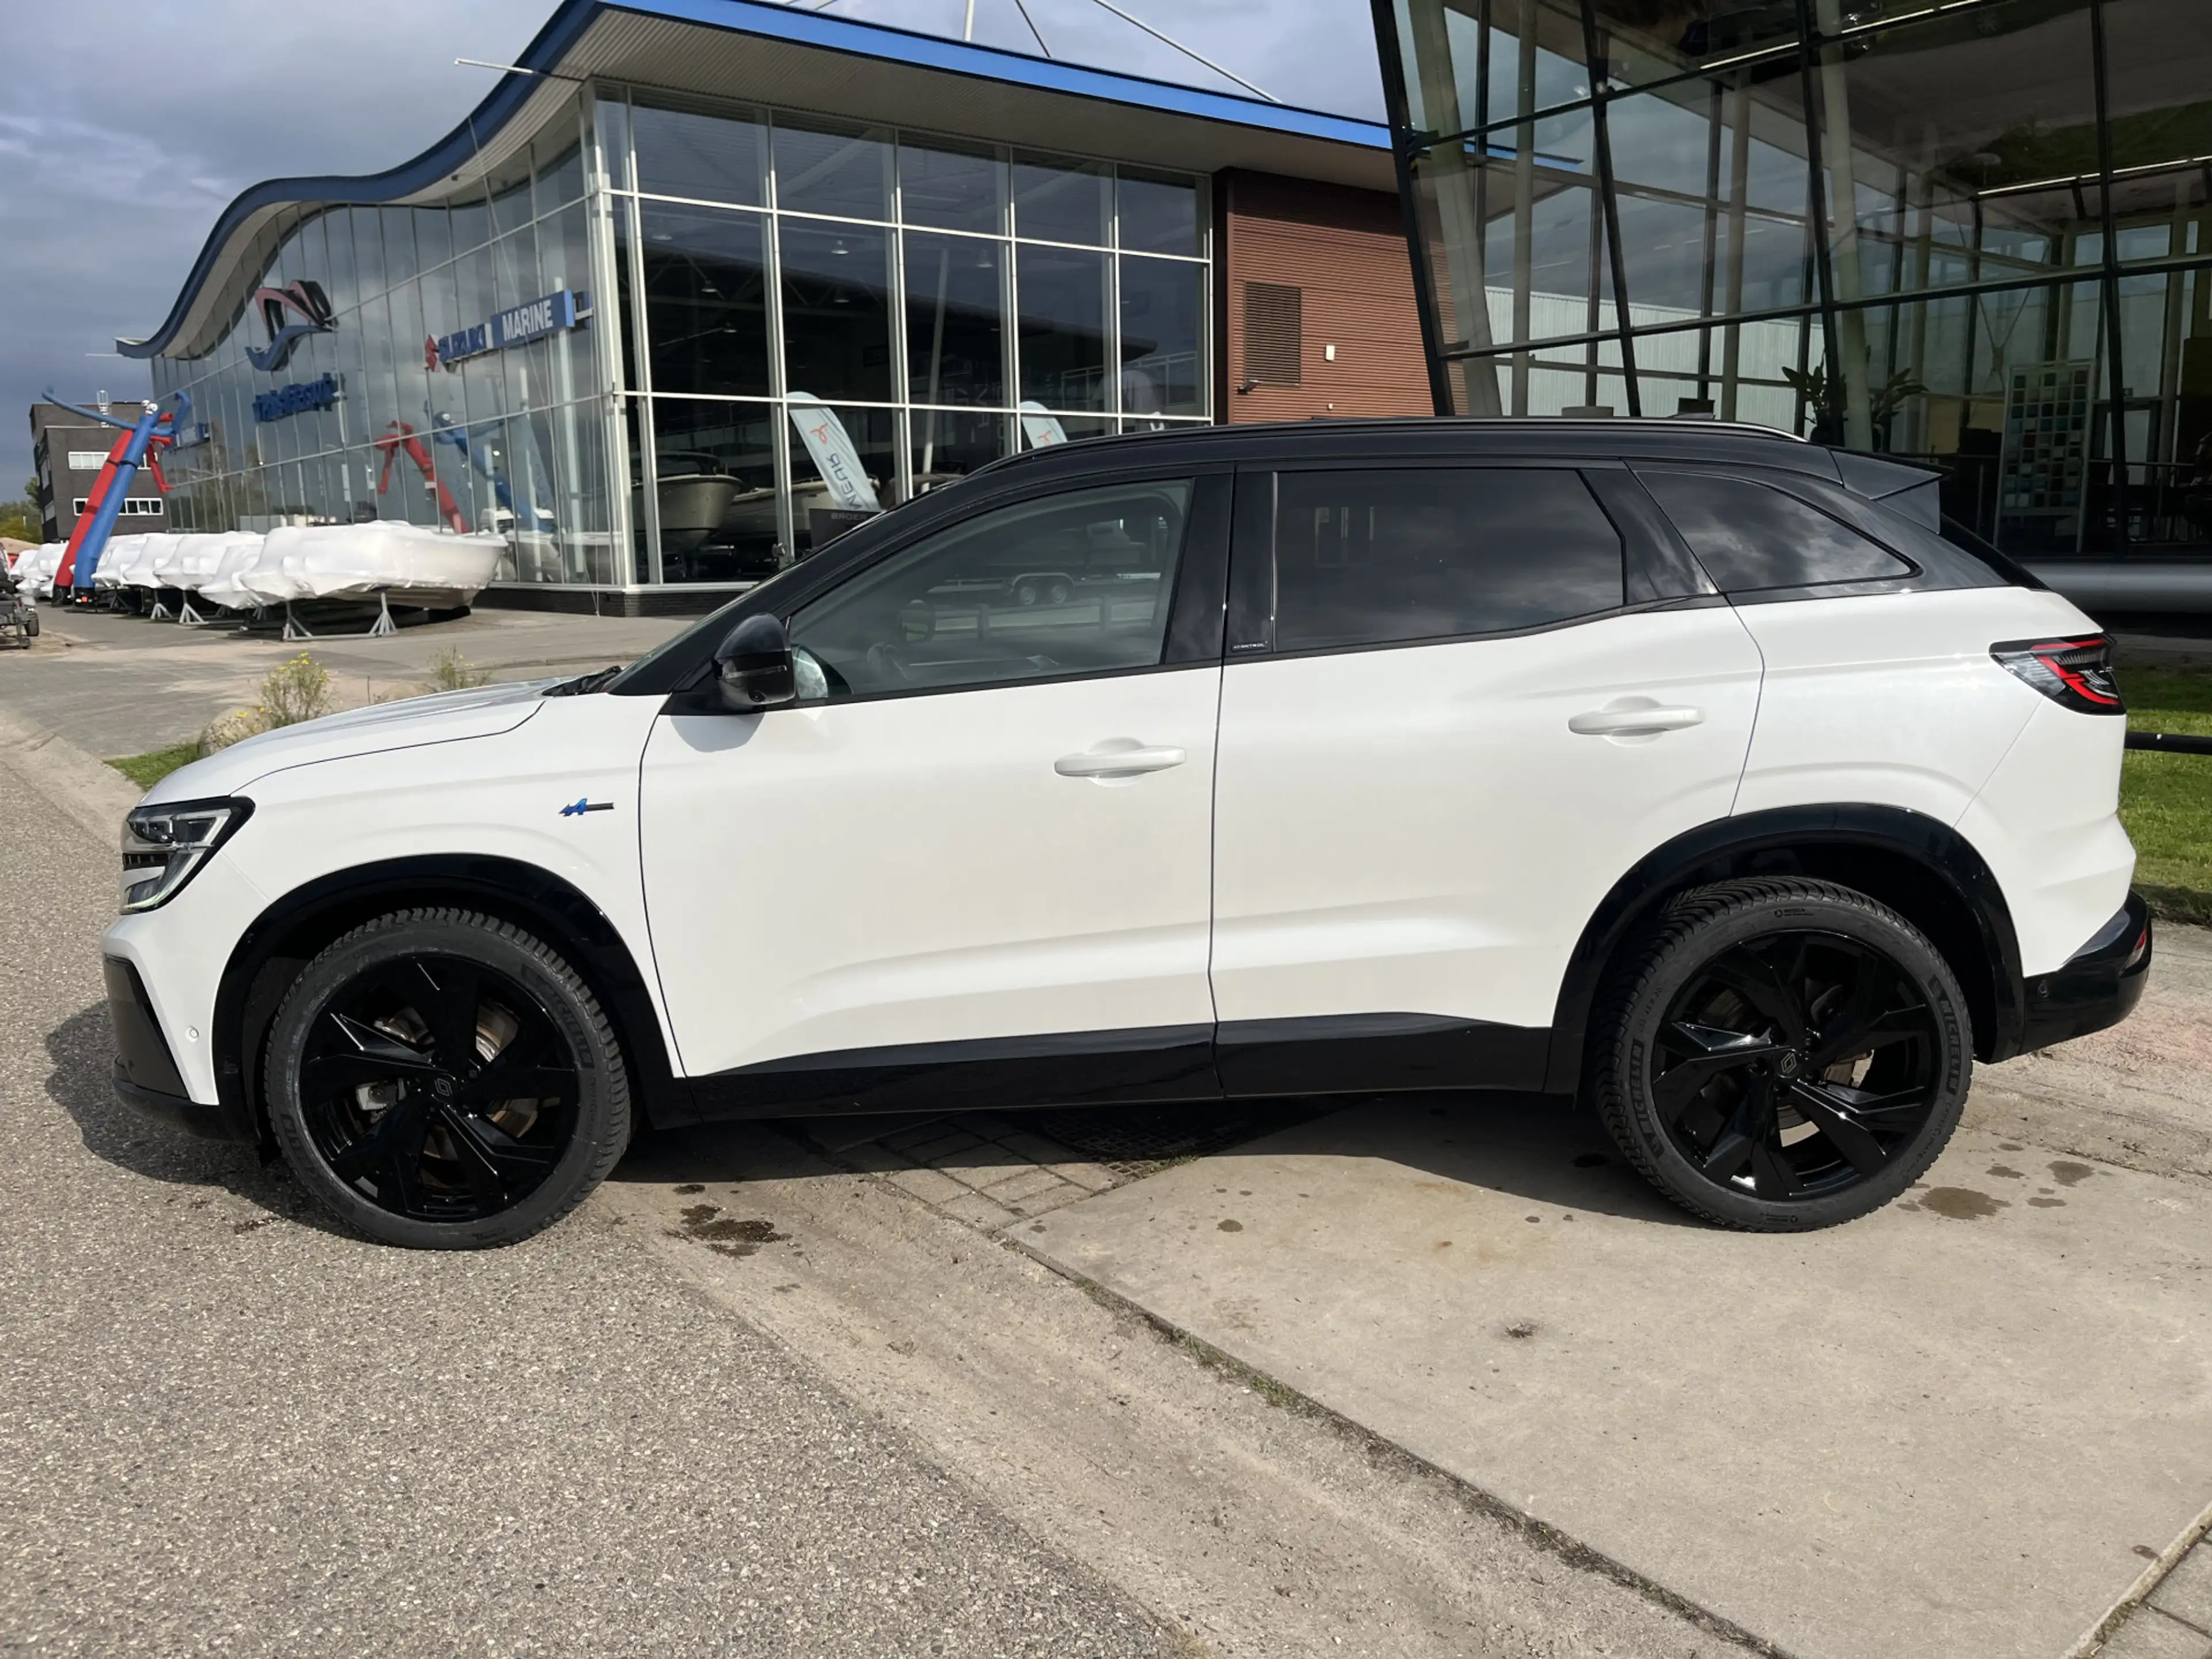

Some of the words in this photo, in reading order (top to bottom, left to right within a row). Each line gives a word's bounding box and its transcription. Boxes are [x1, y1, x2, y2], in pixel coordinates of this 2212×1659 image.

[439, 324, 486, 362] SUZUKI
[502, 300, 553, 341] MARINE
[1938, 999, 1961, 1087] MICHELIN
[1630, 1044, 1655, 1135] MICHELIN
